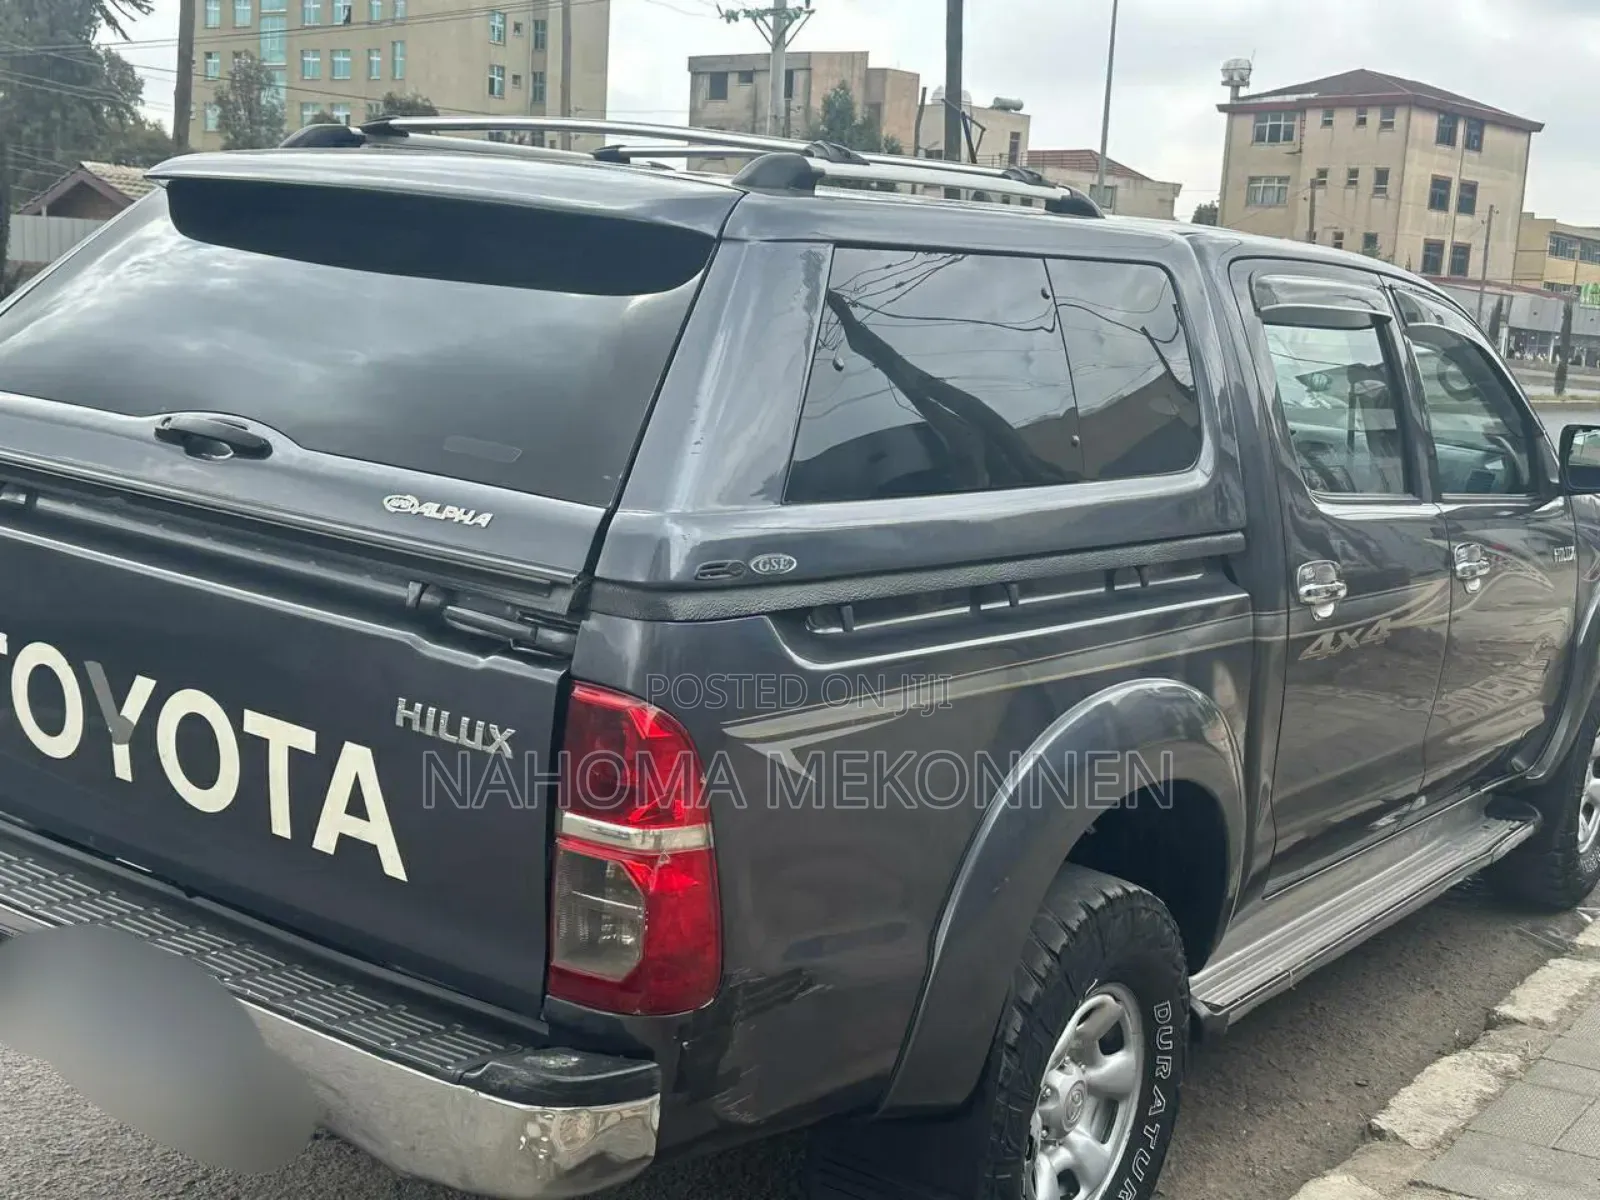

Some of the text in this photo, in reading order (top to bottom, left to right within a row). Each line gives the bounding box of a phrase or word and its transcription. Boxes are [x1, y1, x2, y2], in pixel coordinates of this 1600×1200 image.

[417, 501, 494, 528] ALPHA
[0, 631, 408, 882] OYOTA
[395, 697, 516, 759] HILUX
